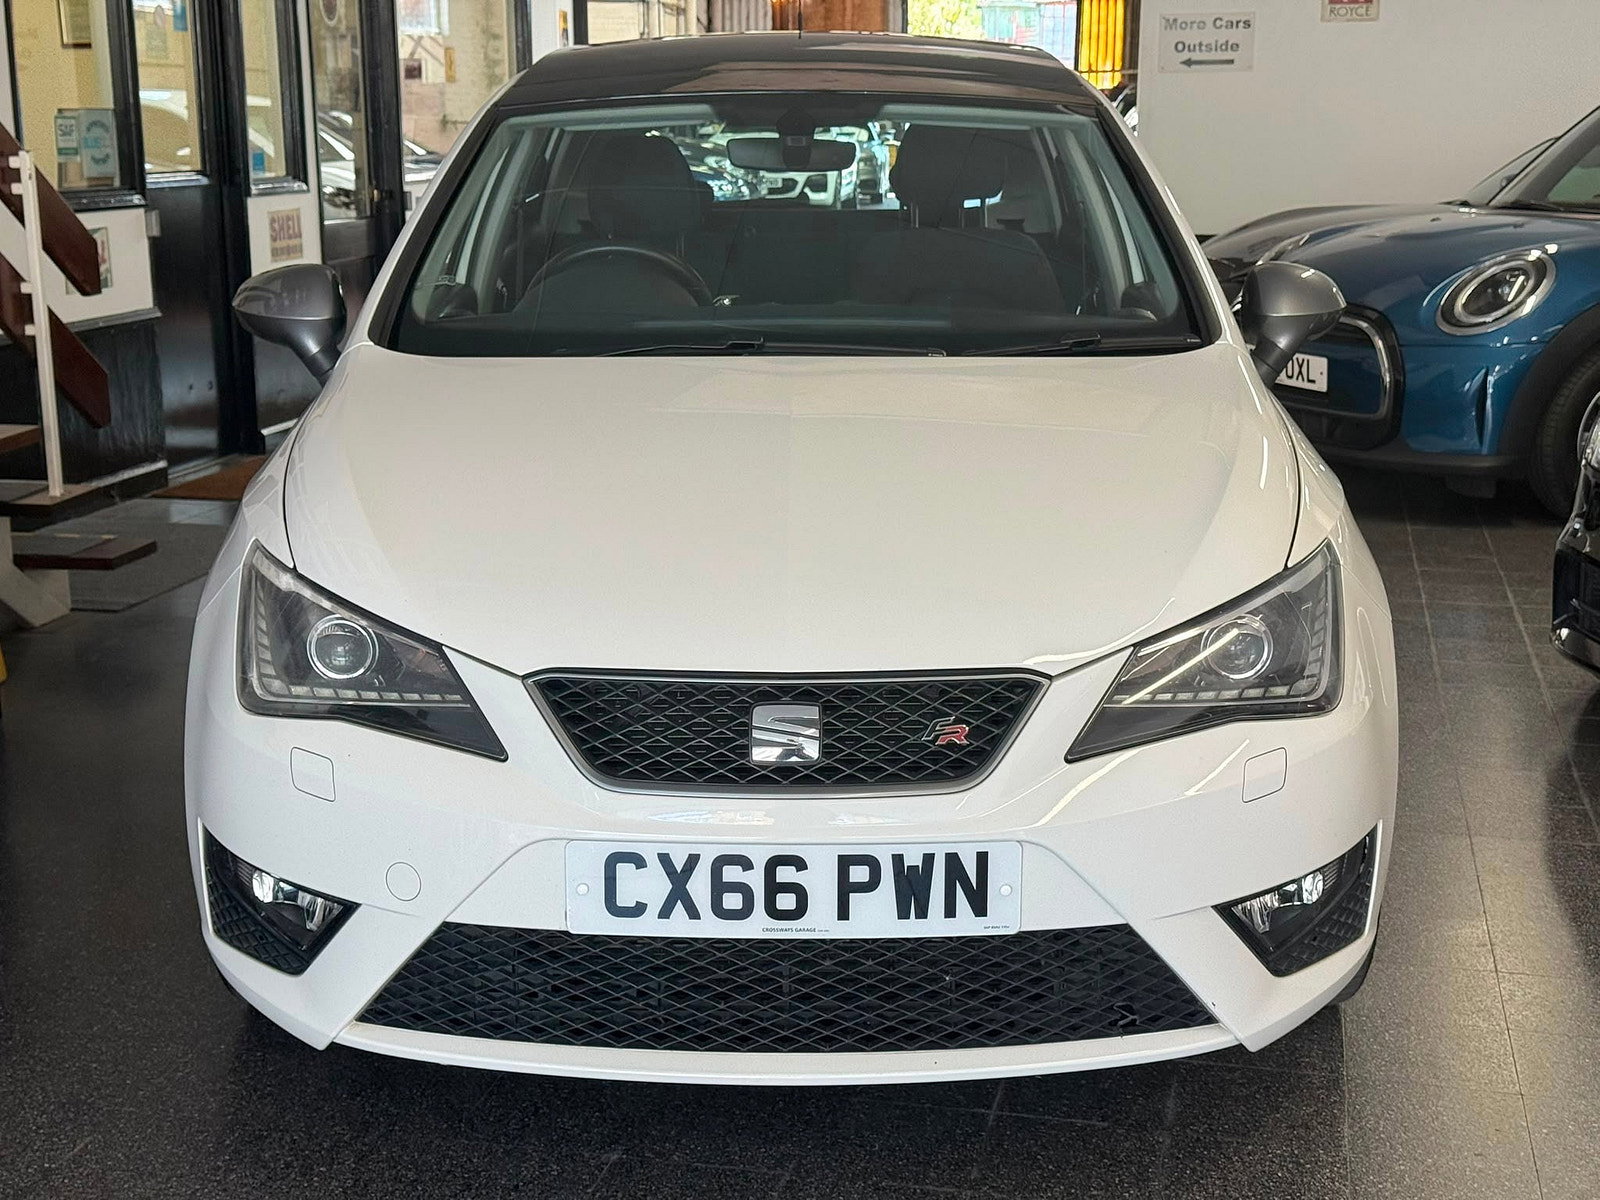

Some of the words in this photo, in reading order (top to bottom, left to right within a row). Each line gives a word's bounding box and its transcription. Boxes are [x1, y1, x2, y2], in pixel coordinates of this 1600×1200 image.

[1329, 6, 1371, 17] ROYCE
[1162, 17, 1207, 31] More
[1213, 17, 1251, 29] Cars
[1174, 40, 1240, 53] Outside
[604, 851, 809, 921] CX66
[837, 851, 989, 921] PWN
